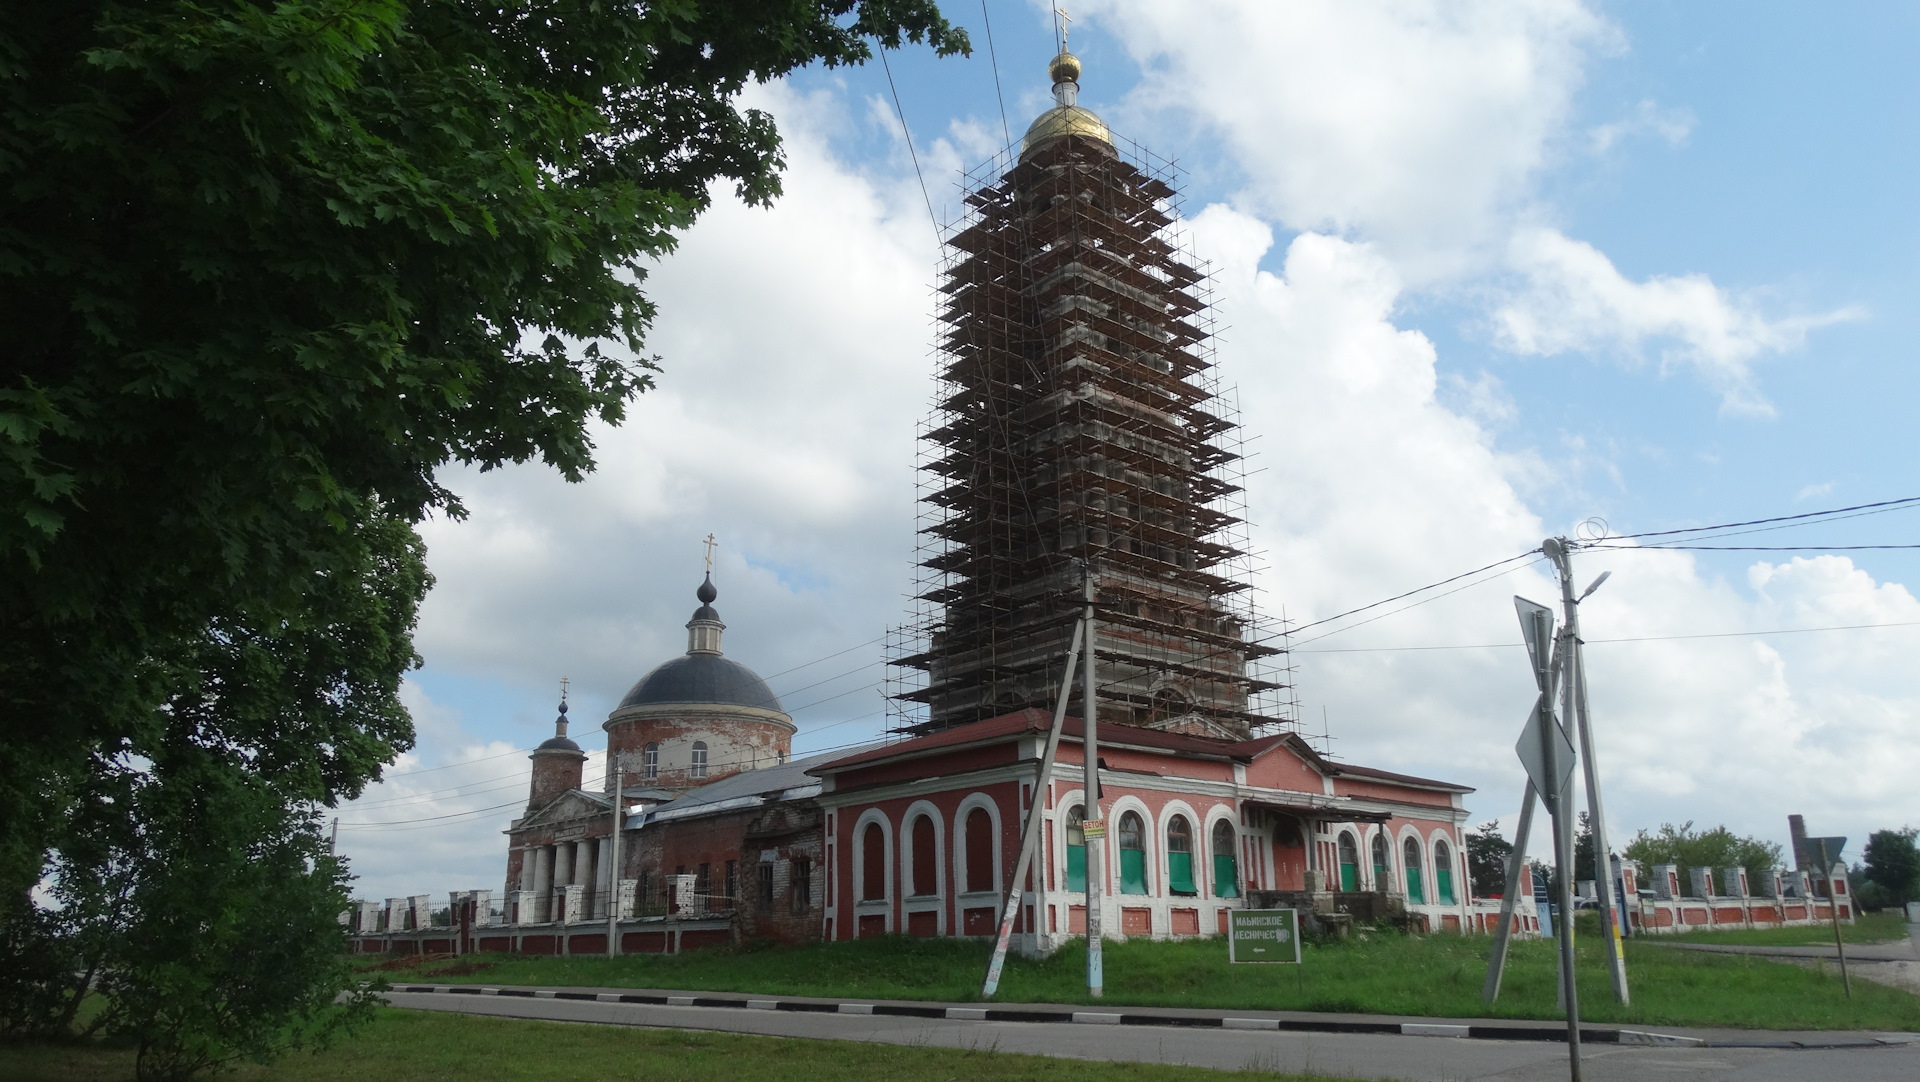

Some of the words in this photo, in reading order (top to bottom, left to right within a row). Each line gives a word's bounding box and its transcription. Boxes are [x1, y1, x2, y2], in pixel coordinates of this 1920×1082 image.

[1084, 820, 1104, 829] БЕТОН
[1236, 916, 1283, 926] ИЛЬИНСКОЕ
[1235, 929, 1290, 940] ЛЕСНИЧЕСТО
